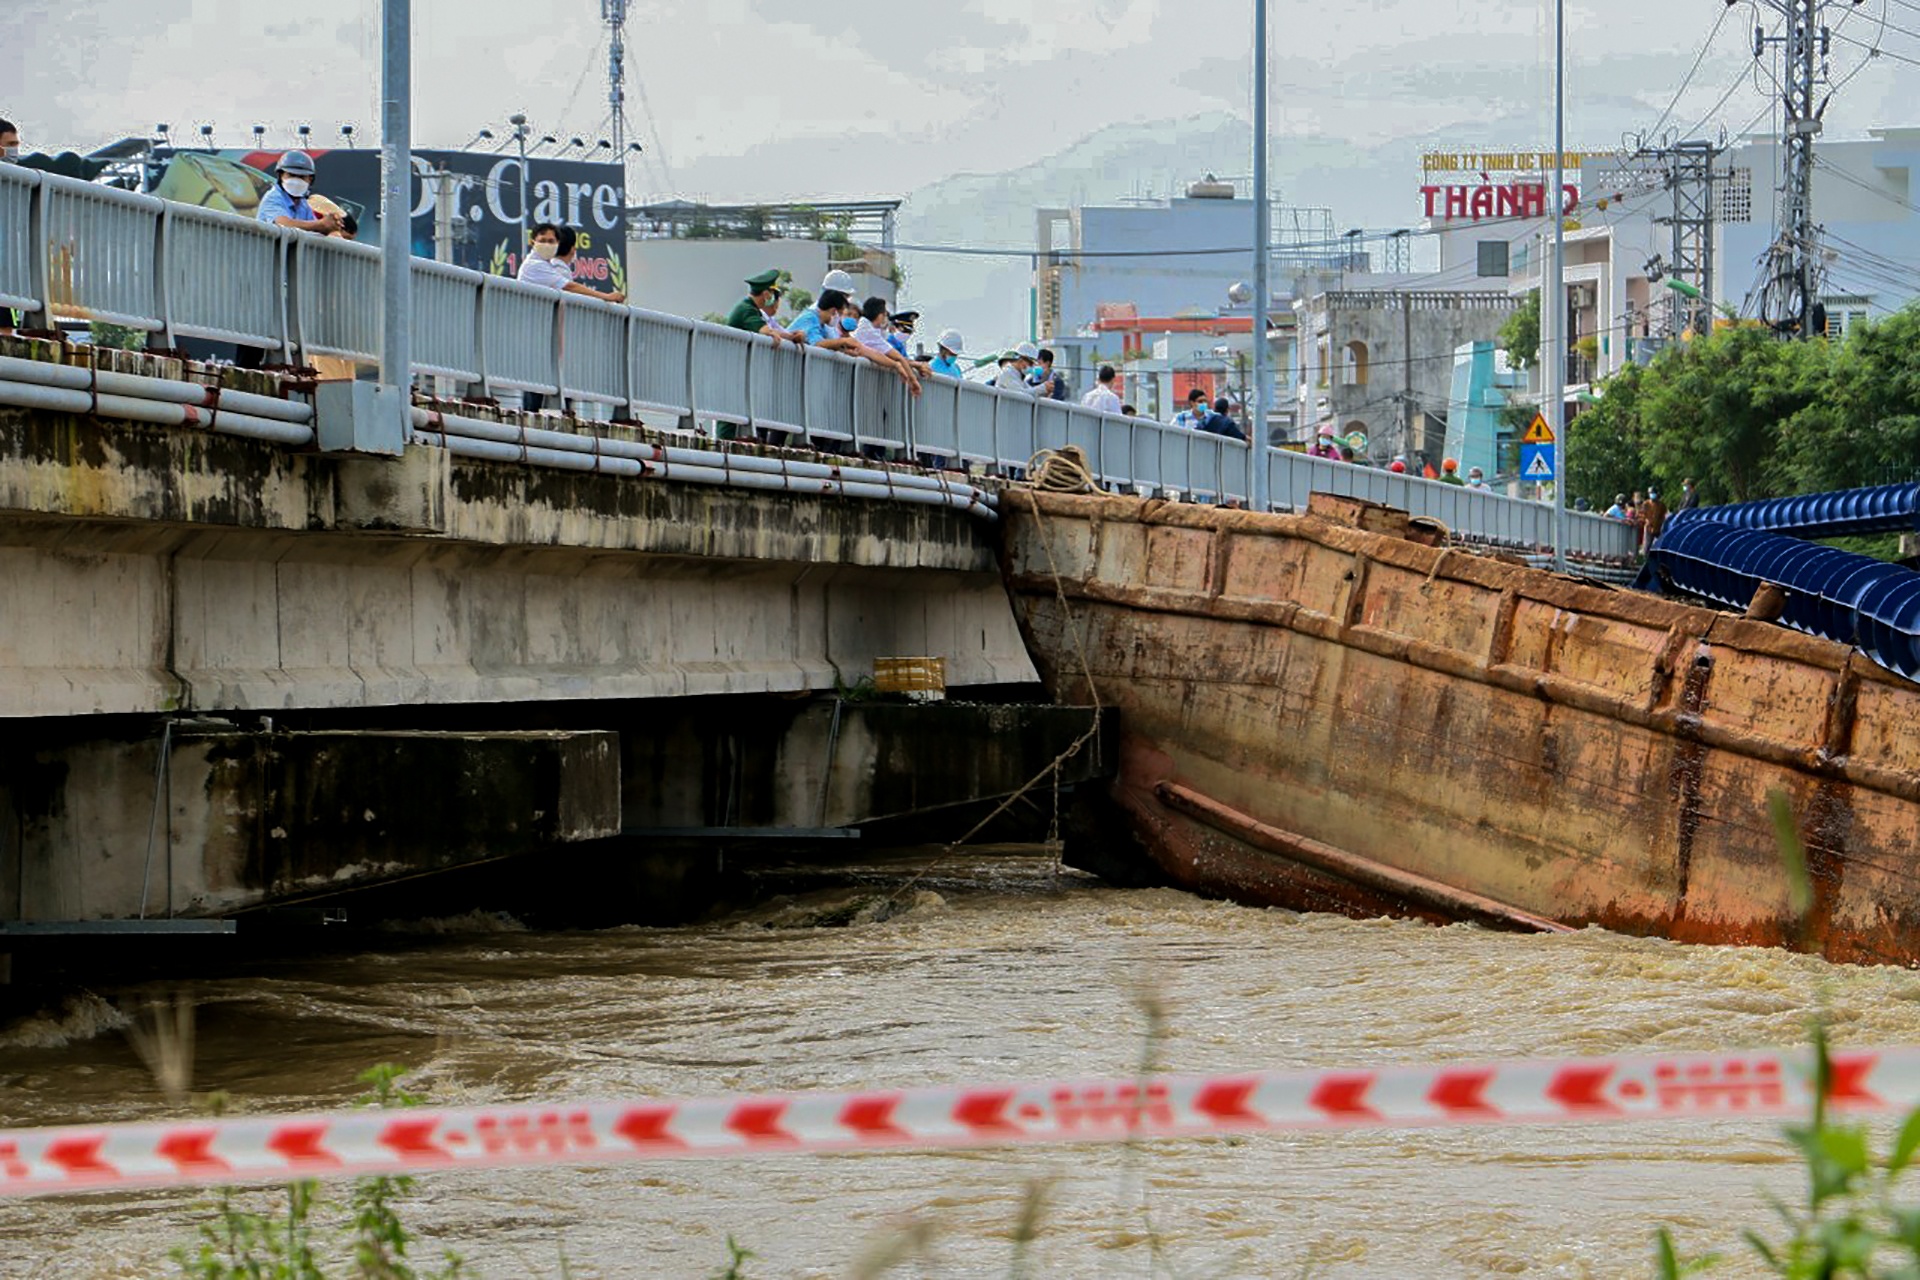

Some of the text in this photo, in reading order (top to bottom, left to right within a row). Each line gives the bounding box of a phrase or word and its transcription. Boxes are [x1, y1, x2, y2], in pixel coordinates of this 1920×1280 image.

[1463, 153, 1477, 170] TY
[1482, 153, 1514, 170] TNHH
[1420, 171, 1545, 221] THÀNH
